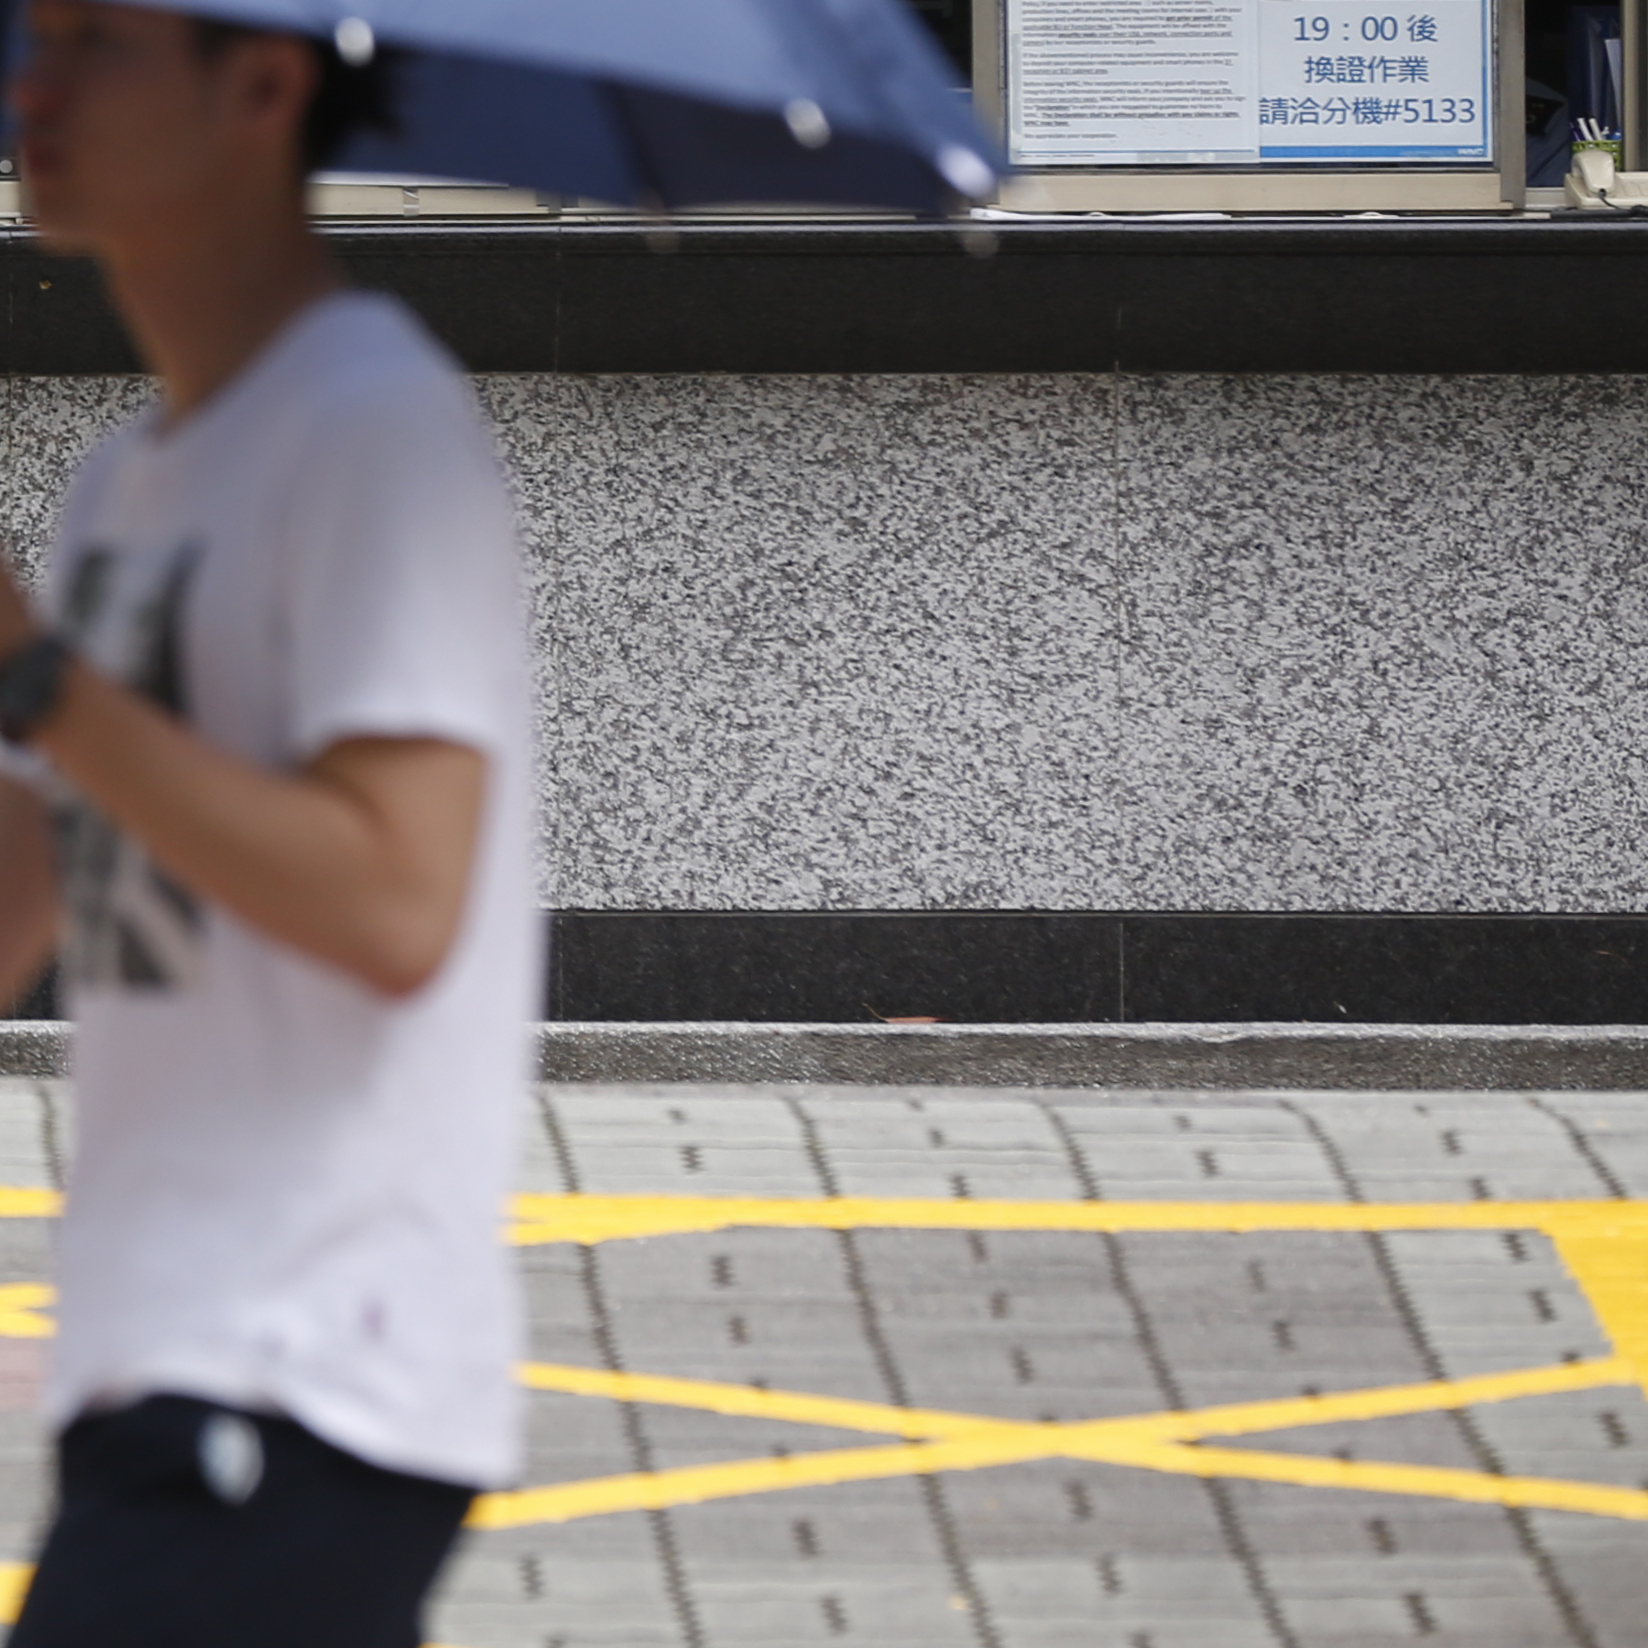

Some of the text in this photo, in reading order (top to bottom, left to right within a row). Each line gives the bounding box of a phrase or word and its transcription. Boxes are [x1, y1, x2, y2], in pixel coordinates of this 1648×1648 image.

[1304, 55, 1429, 83] 換證作業
[1259, 97, 1476, 125] 請洽分機#5133
